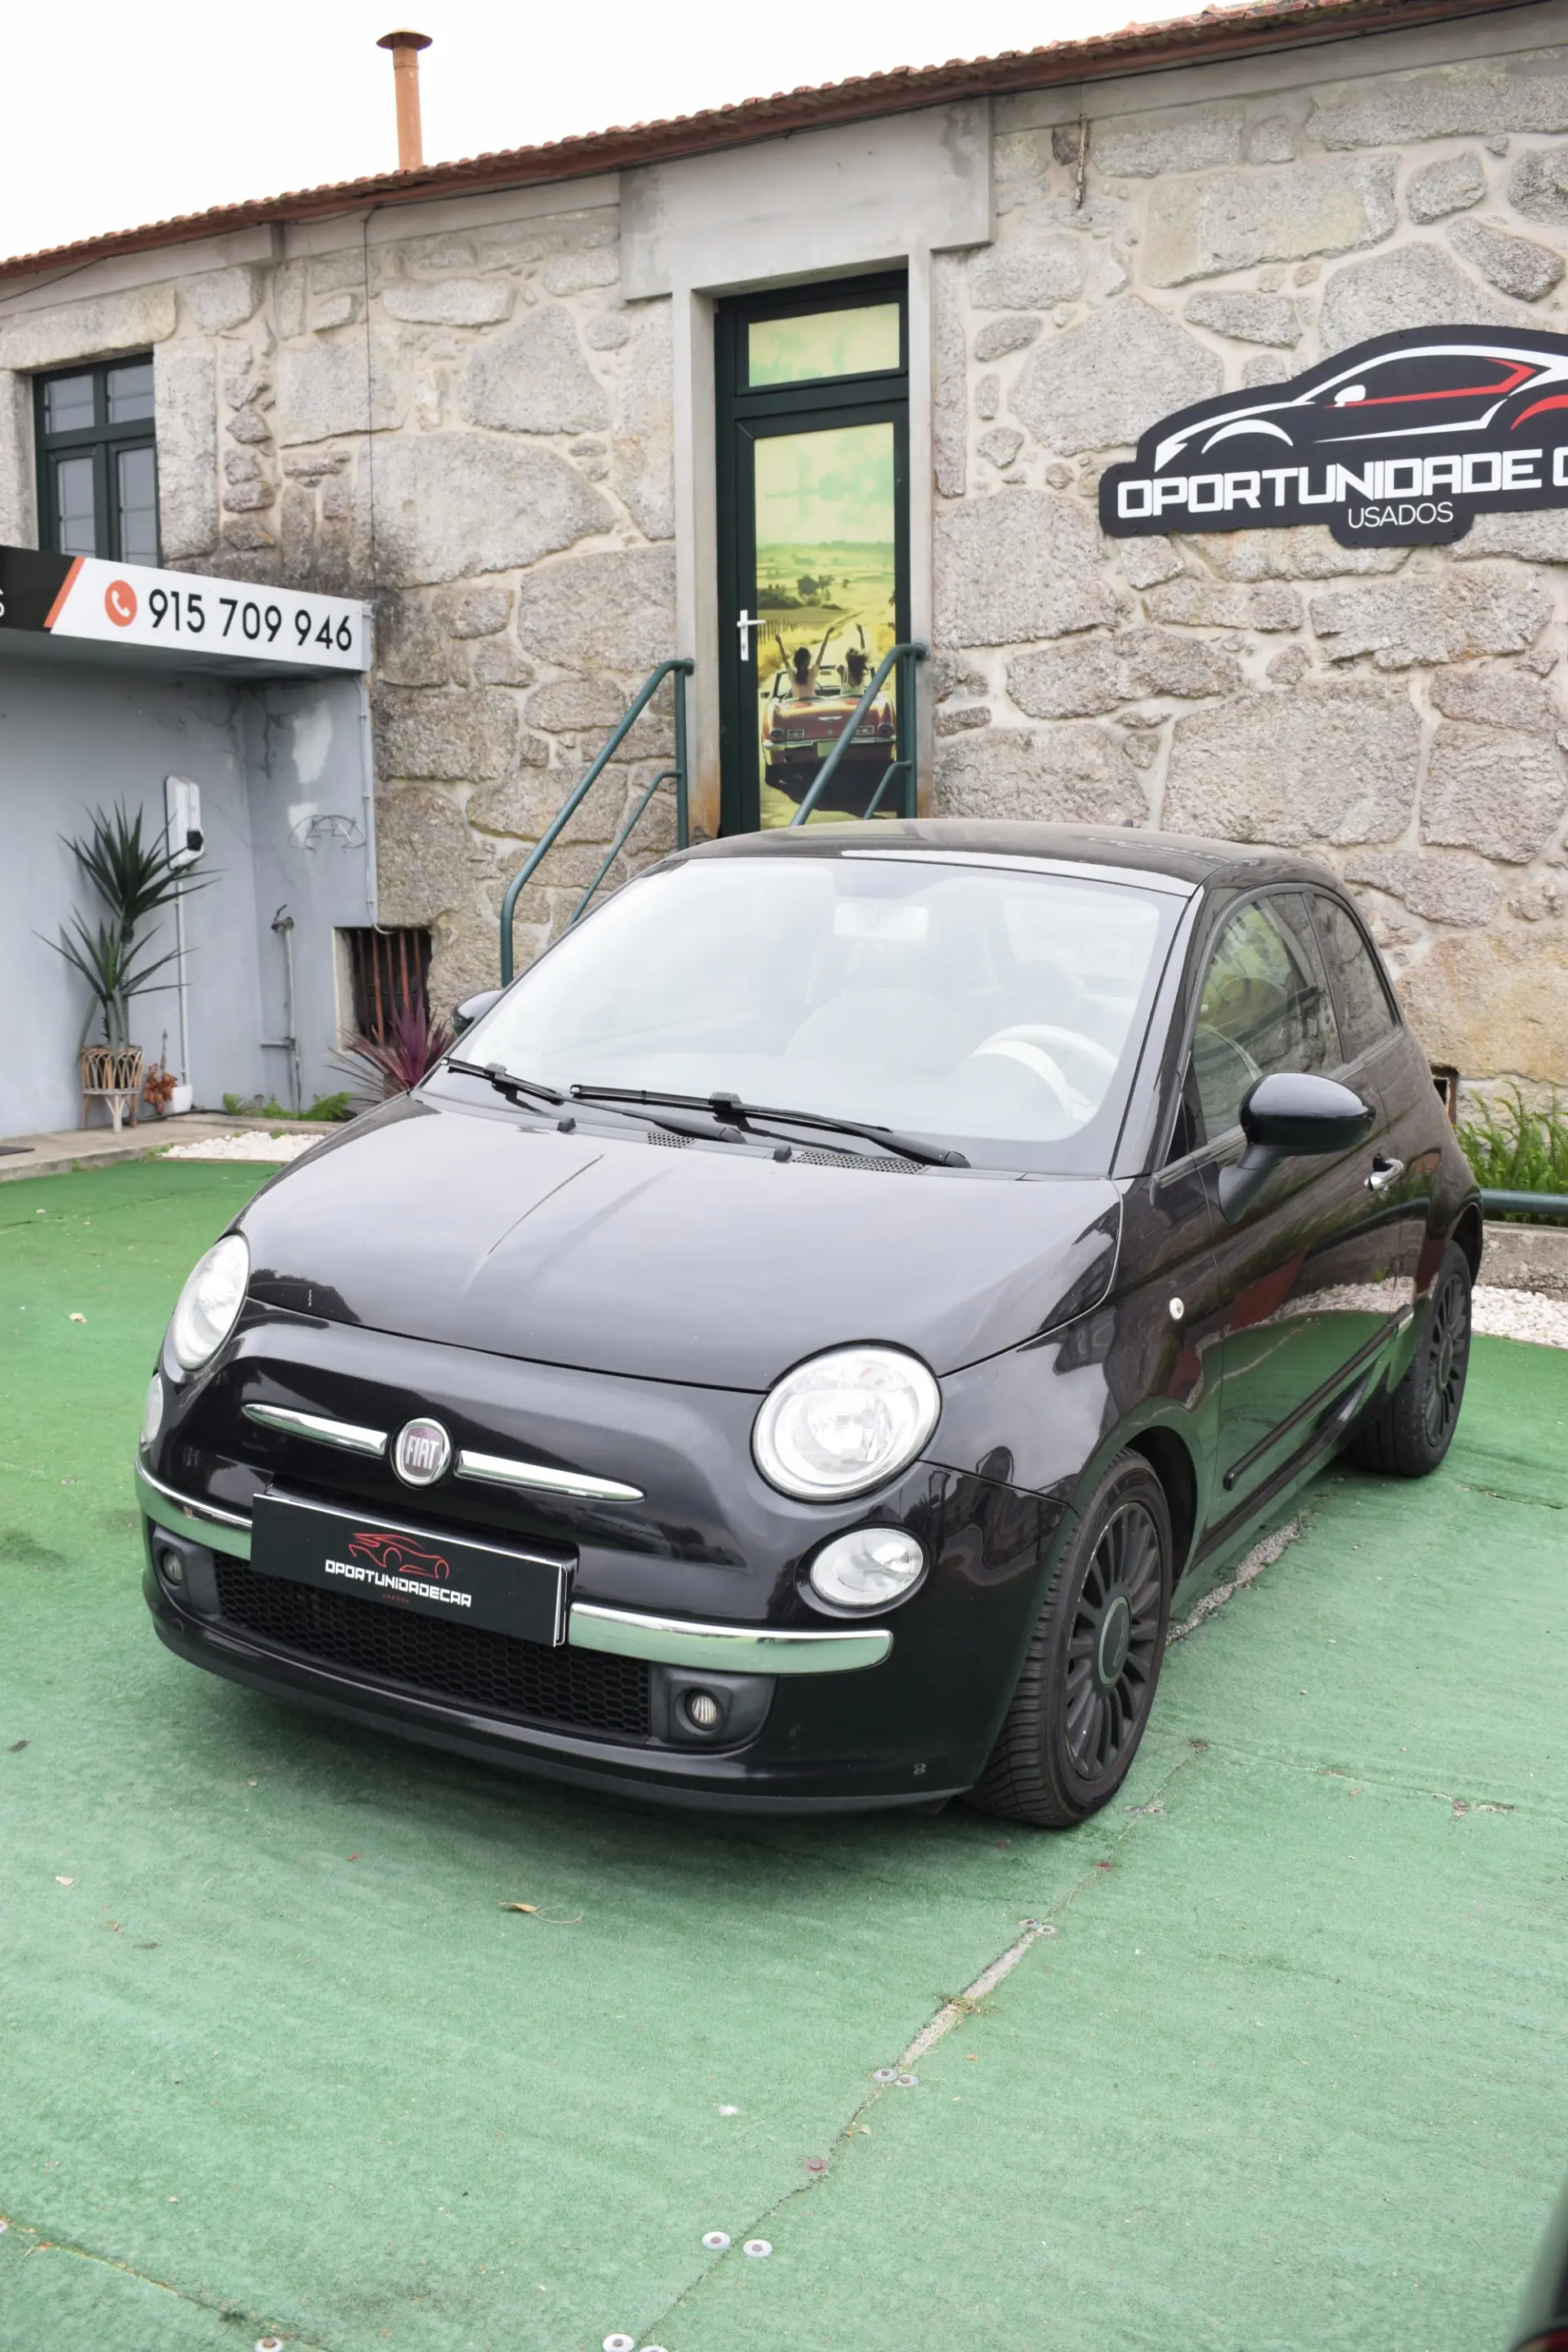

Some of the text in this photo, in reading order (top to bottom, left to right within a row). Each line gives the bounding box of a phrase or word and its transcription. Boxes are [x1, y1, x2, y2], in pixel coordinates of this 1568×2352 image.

[1117, 448, 1543, 519] OPORTUNIDADE
[1348, 501, 1454, 528] USADOS
[148, 588, 352, 652] 915 709 946
[404, 1435, 439, 1471] FIAT
